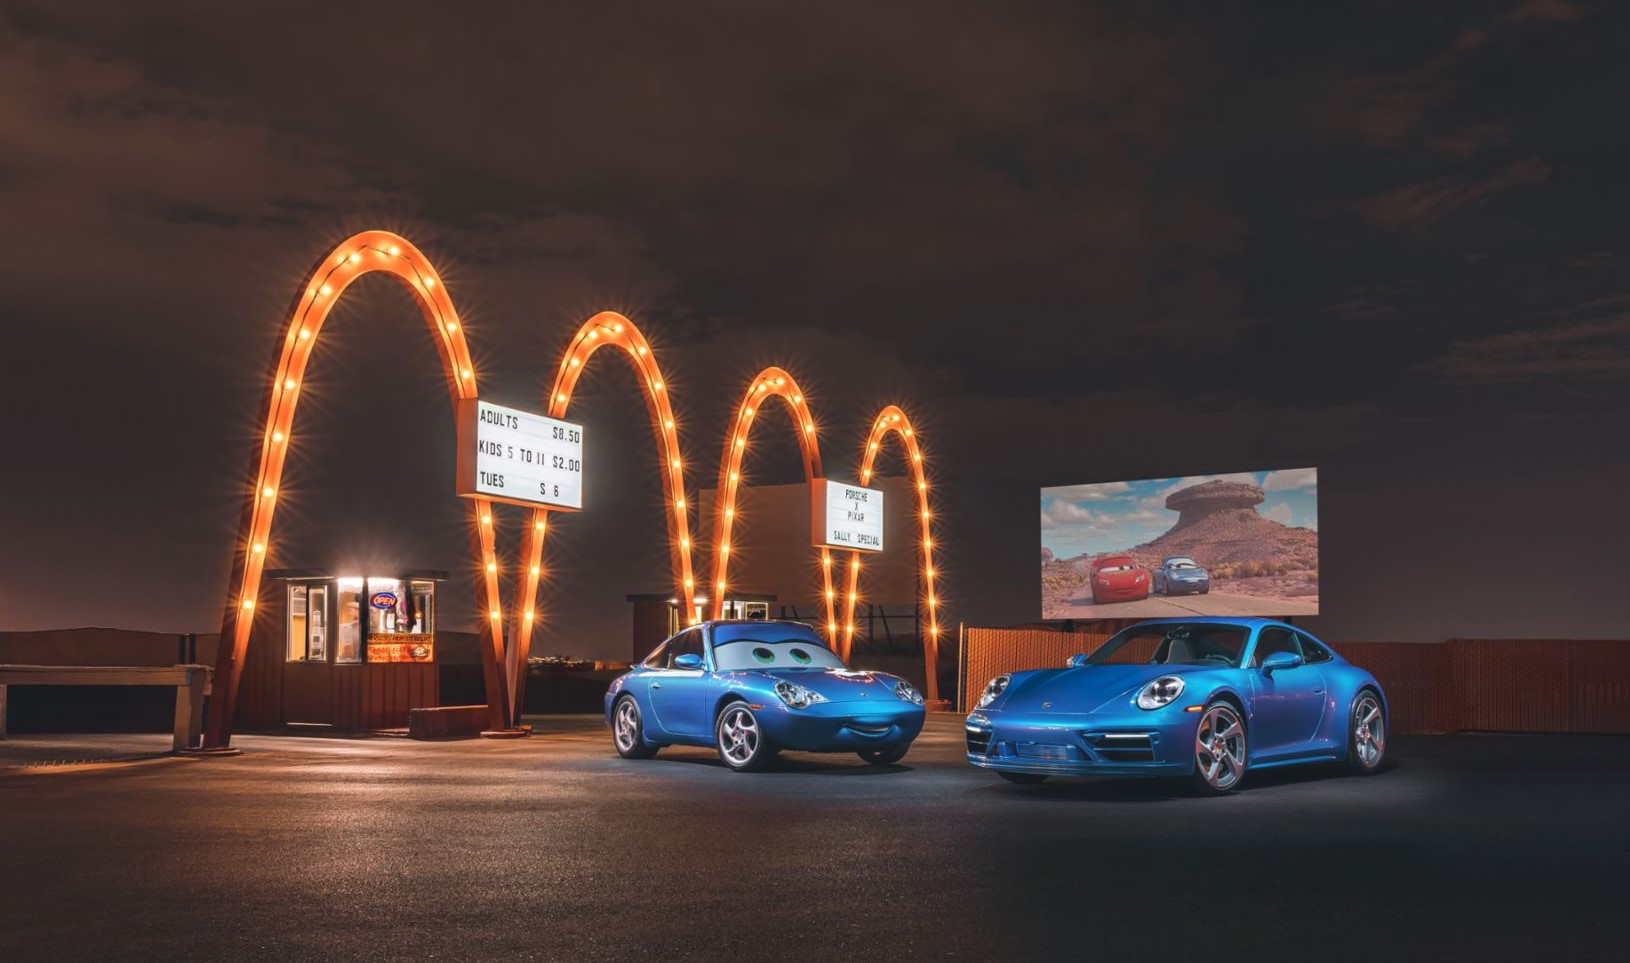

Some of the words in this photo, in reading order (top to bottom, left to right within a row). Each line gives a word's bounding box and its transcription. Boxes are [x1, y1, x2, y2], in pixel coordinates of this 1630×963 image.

[480, 409, 518, 429] ADULTS
[479, 440, 502, 457] KIDS
[508, 446, 513, 459] 5
[520, 449, 532, 463] TO
[480, 471, 504, 488] TUES
[554, 485, 559, 497] 6
[845, 489, 868, 502] PORSCHE
[854, 502, 859, 511] X
[848, 511, 865, 522] PIXAR
[834, 530, 851, 542] SALLY
[858, 534, 880, 546] SPECIAL
[373, 596, 396, 605] OPEN
